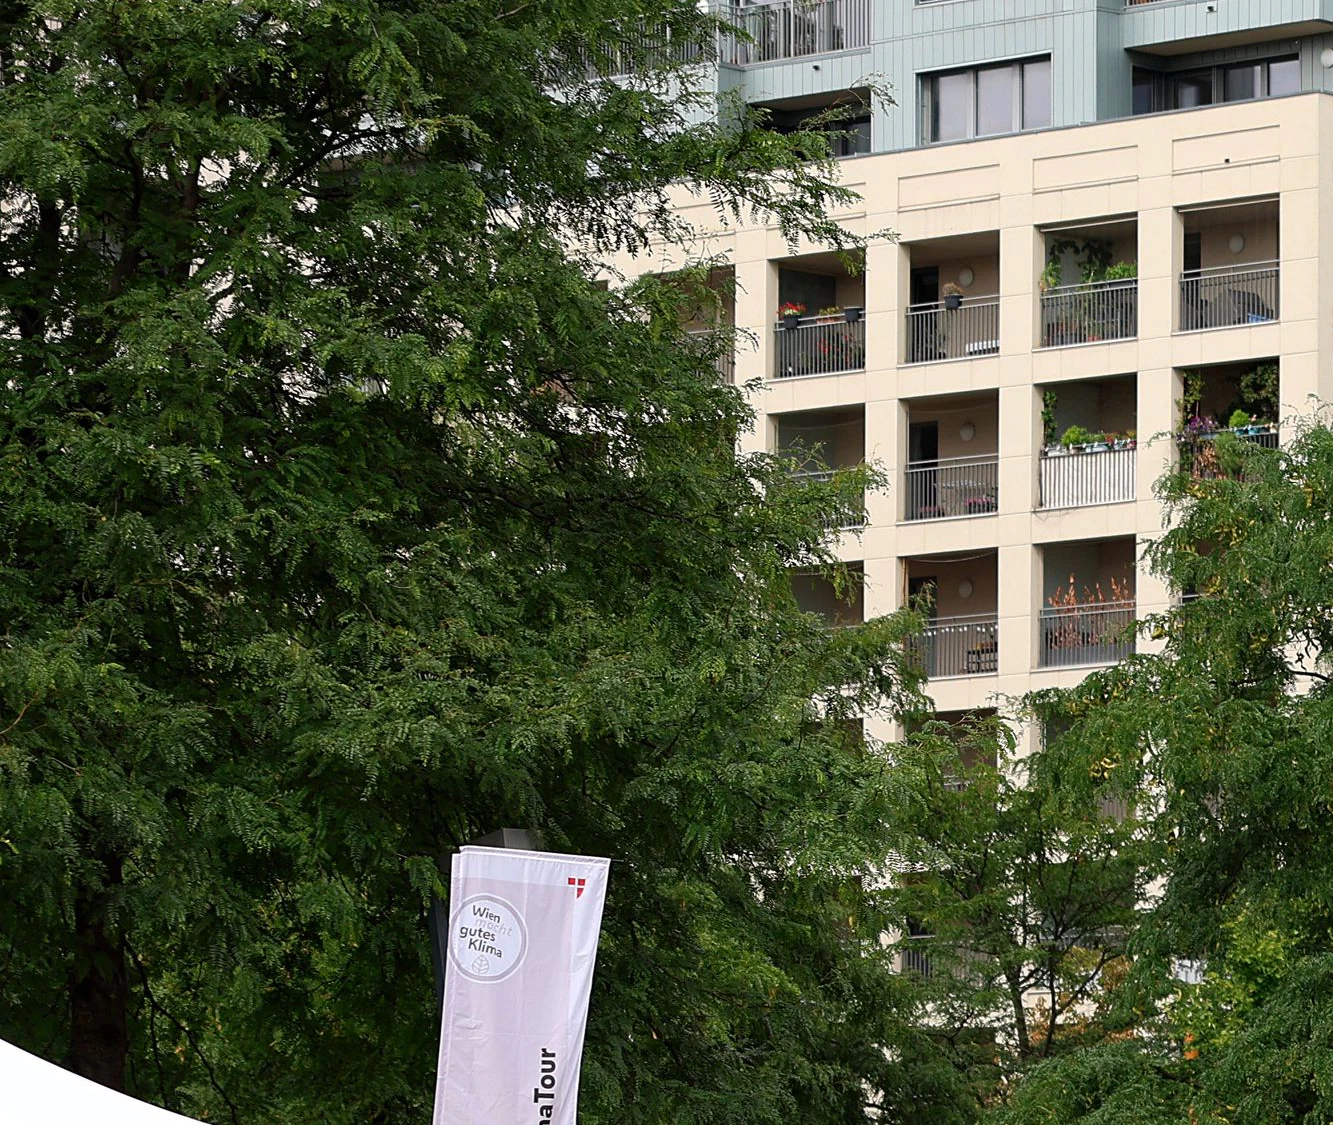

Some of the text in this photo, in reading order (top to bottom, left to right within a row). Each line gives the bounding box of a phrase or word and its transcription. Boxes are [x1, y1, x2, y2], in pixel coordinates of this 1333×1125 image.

[472, 905, 501, 923] Wien
[460, 926, 496, 942] gutes
[475, 918, 512, 936] macht
[468, 938, 502, 958] Klima
